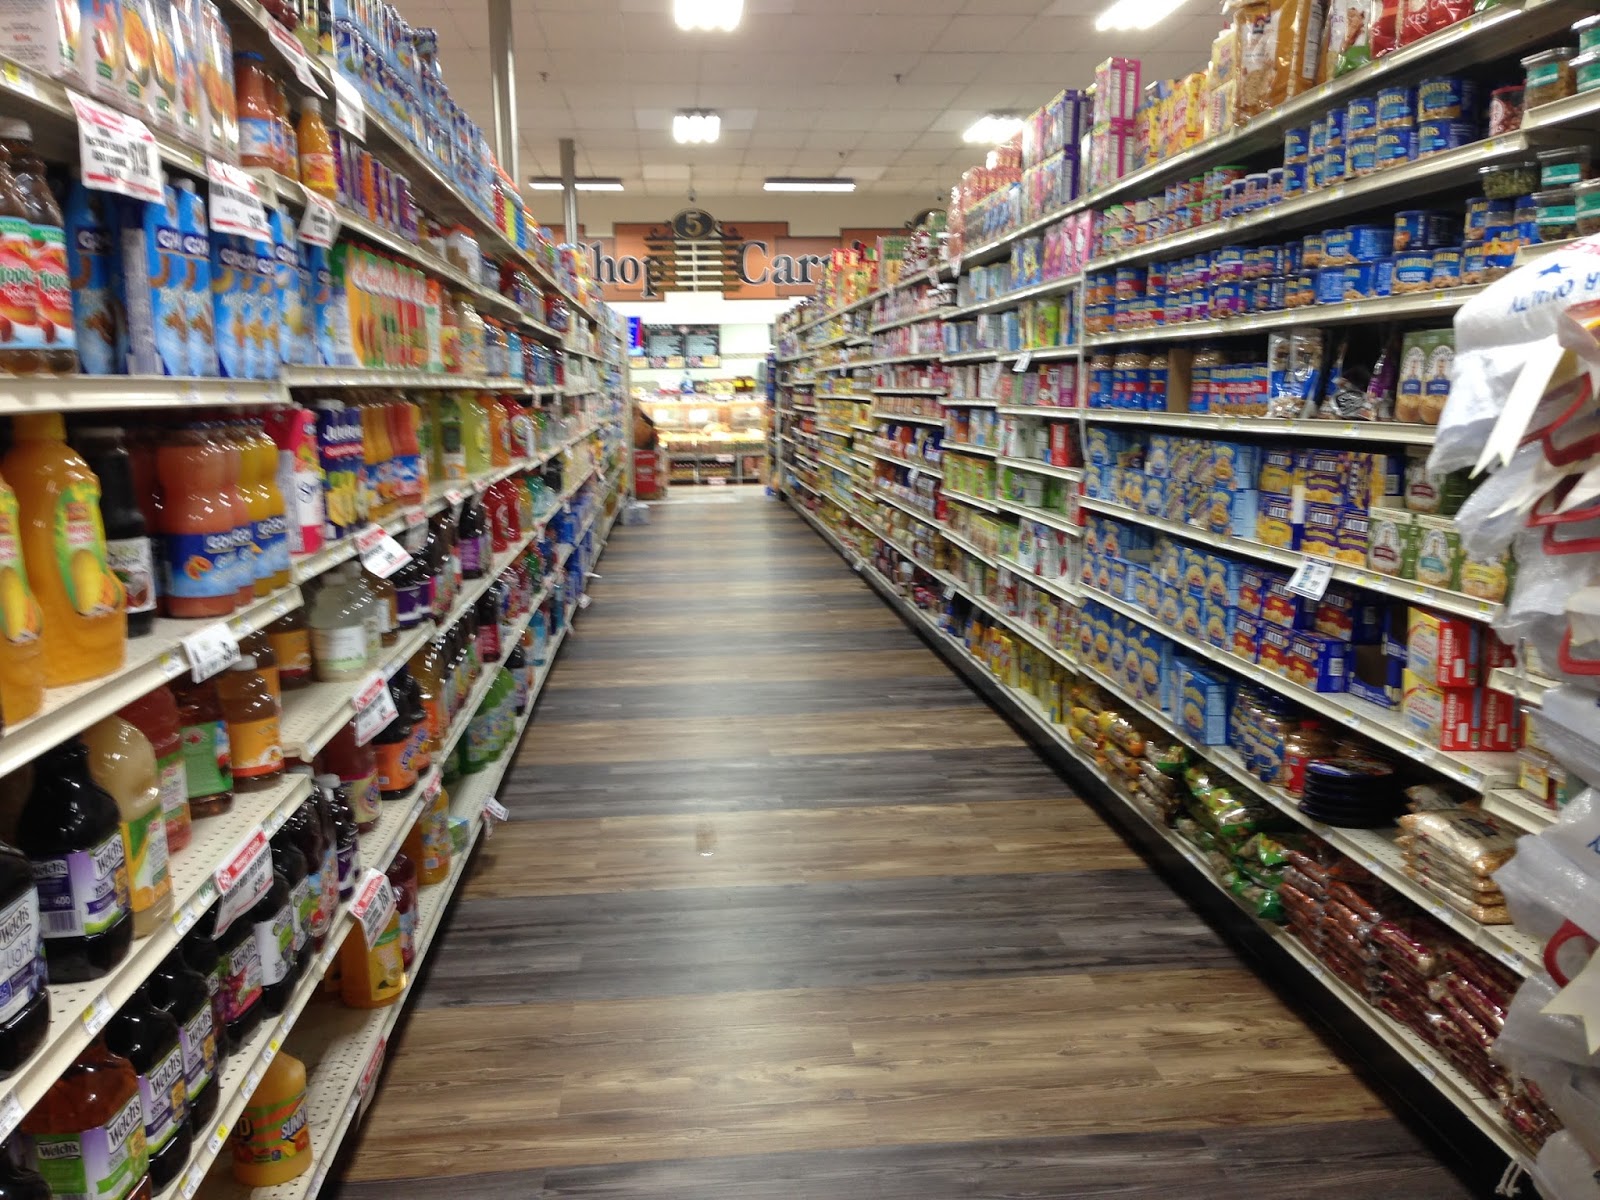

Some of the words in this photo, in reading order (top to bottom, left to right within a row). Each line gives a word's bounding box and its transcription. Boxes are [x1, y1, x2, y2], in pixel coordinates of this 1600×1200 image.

[684, 210, 704, 239] 5
[576, 240, 660, 298] hop
[738, 240, 831, 287] Car
[0, 906, 31, 944] Welch's
[151, 1051, 182, 1095] Welch's
[107, 1098, 142, 1148] Welch's
[39, 1143, 80, 1158] Welch's
